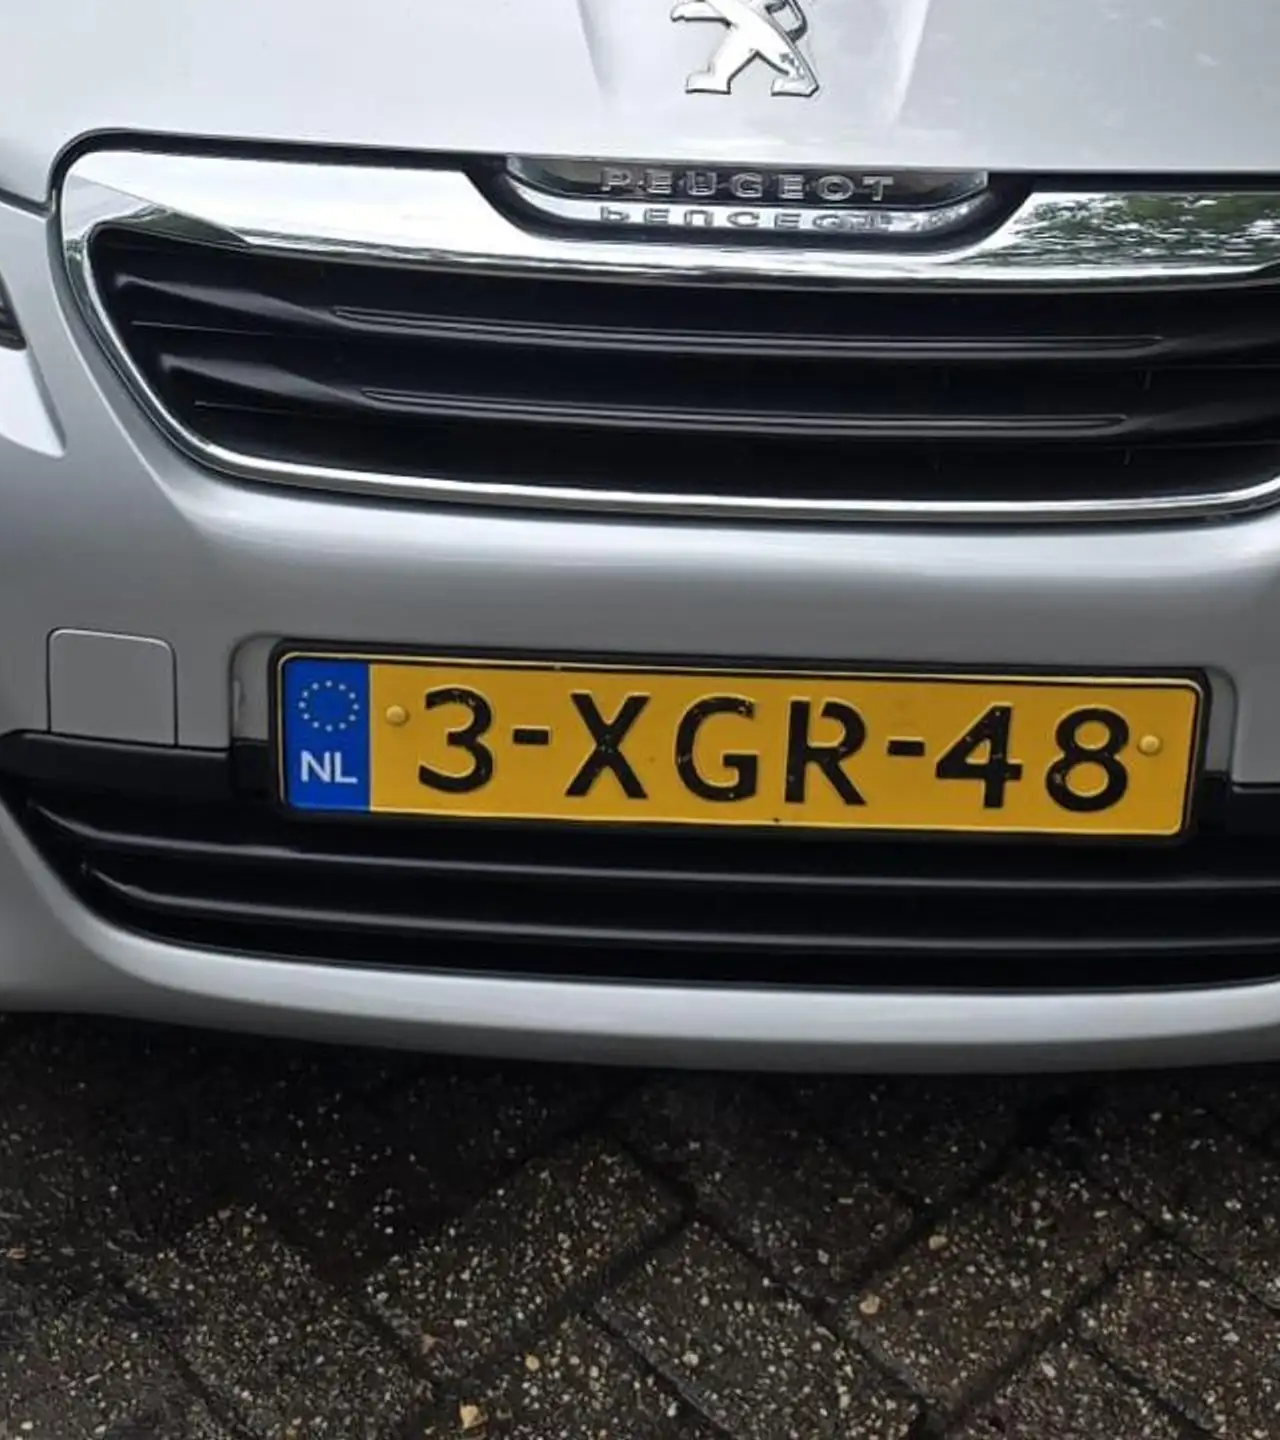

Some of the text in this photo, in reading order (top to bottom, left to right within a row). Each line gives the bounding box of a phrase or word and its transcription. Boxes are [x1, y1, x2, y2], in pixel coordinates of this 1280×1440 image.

[600, 167, 894, 202] PEUGEOT
[300, 750, 358, 785] NL
[417, 687, 1132, 813] 3-XGR-48
